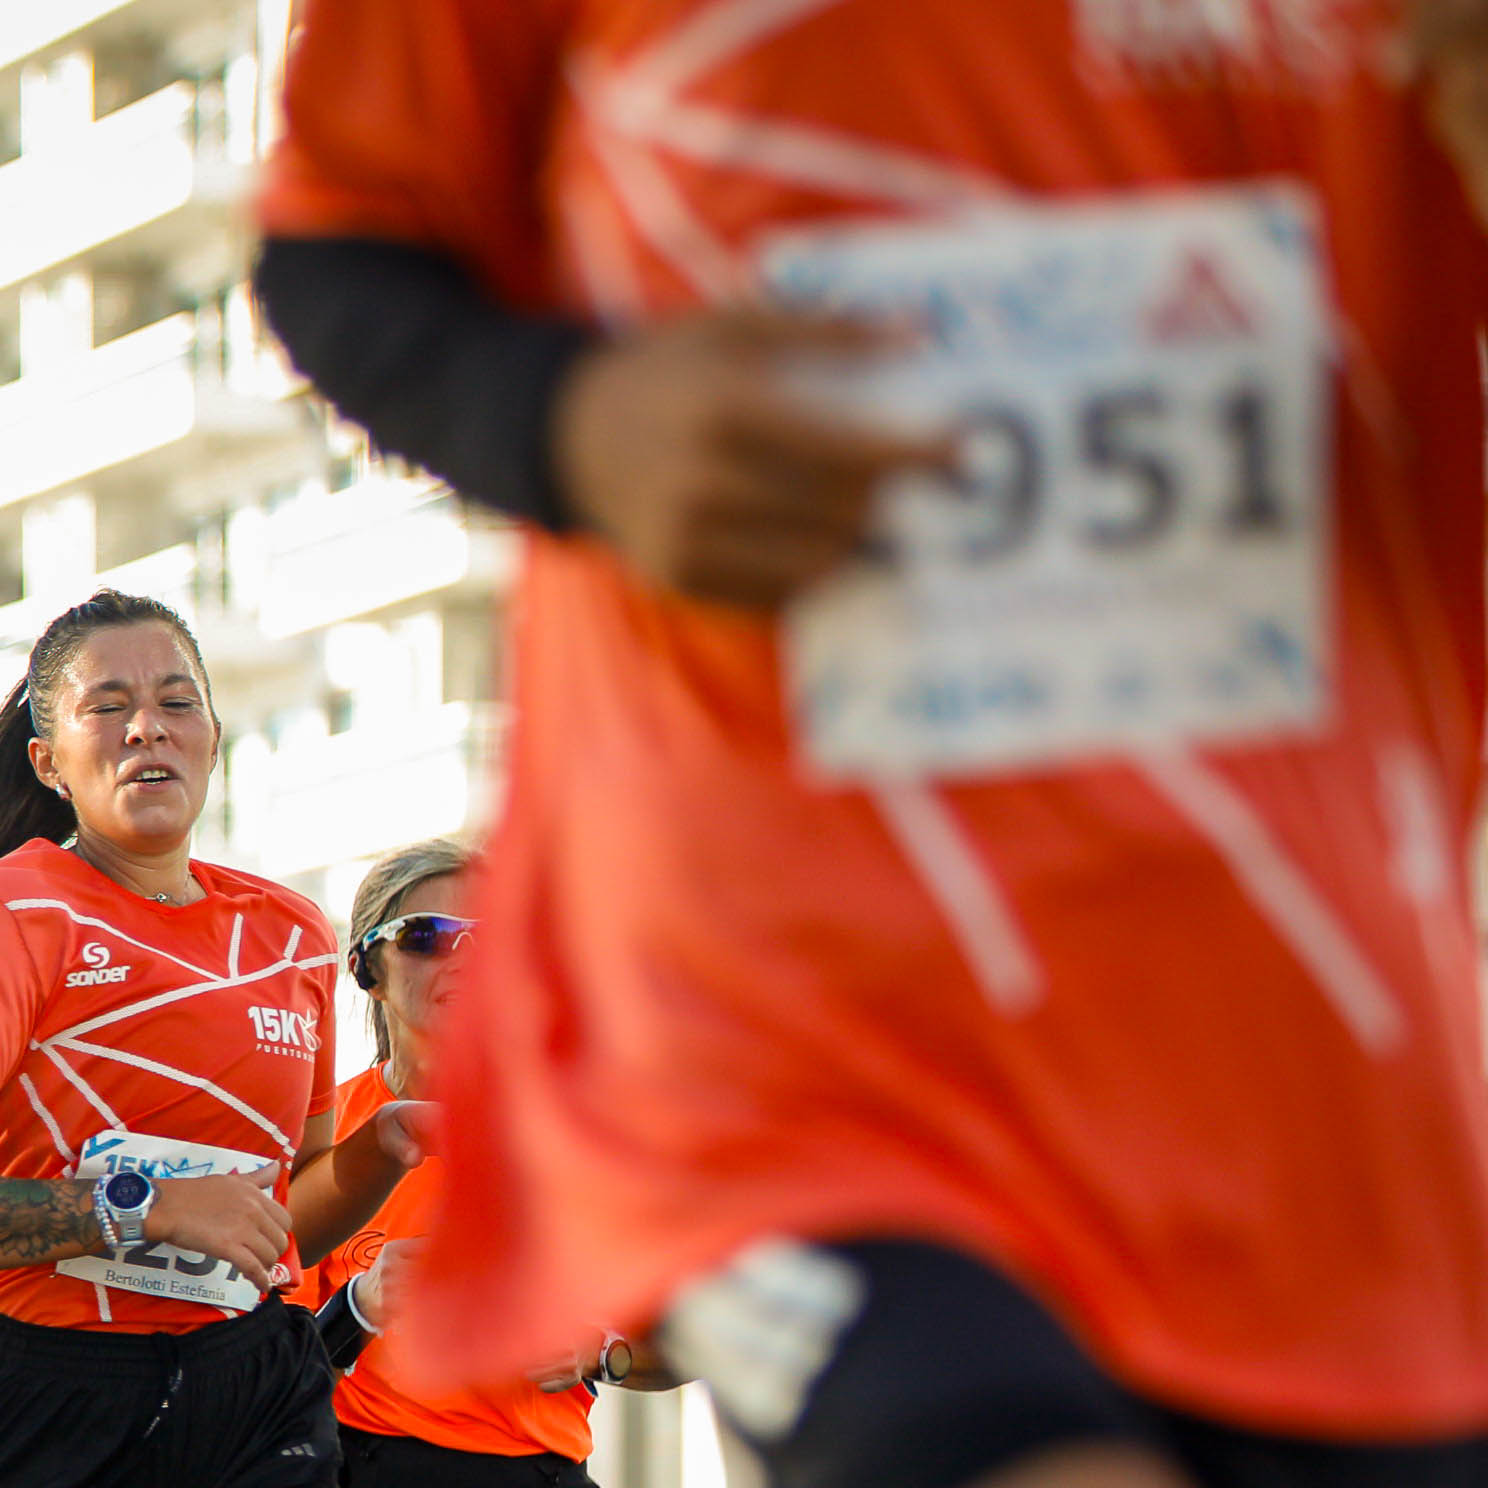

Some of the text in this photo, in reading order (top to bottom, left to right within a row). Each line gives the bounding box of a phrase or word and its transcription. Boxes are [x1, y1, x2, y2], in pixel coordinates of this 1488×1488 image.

[856, 378, 1286, 568] 951
[248, 1006, 300, 1046] 15K
[104, 1269, 166, 1292] Bertolotti
